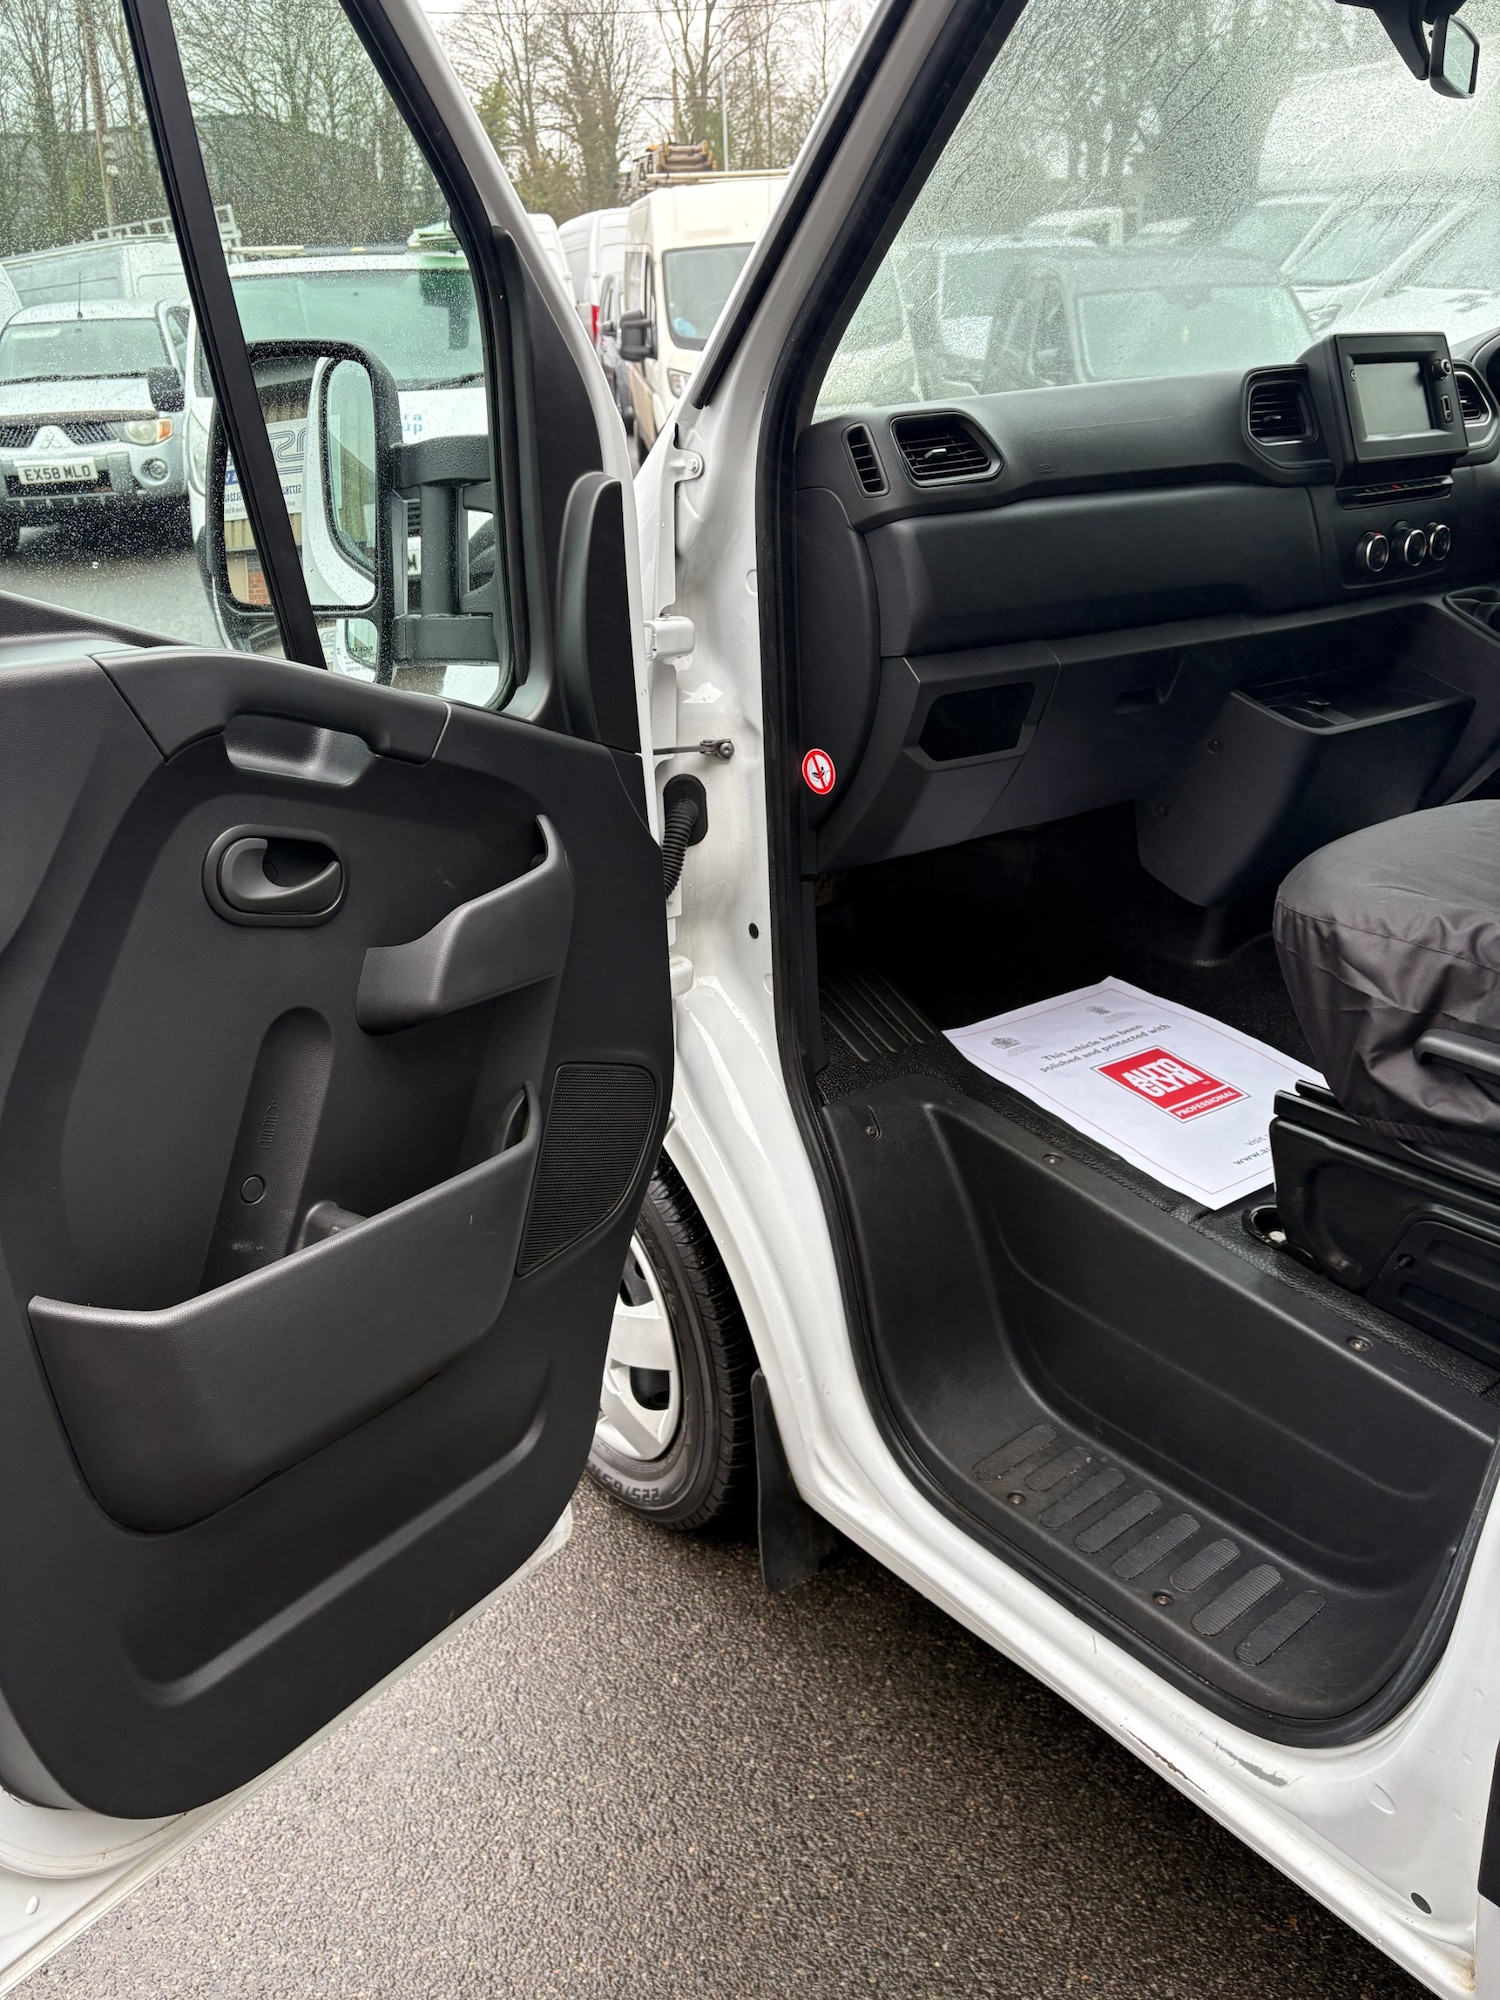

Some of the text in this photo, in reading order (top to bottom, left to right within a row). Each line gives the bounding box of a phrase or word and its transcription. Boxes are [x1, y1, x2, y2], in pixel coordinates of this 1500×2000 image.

[23, 467, 61, 481] EX58
[1040, 1023, 1170, 1072] polished and protected with
[1043, 1024, 1143, 1061] This vehicle has been
[1121, 1058, 1184, 1088] AUTO
[1137, 1067, 1205, 1098] GLYM
[1174, 1090, 1237, 1117] PROFESSIONAL
